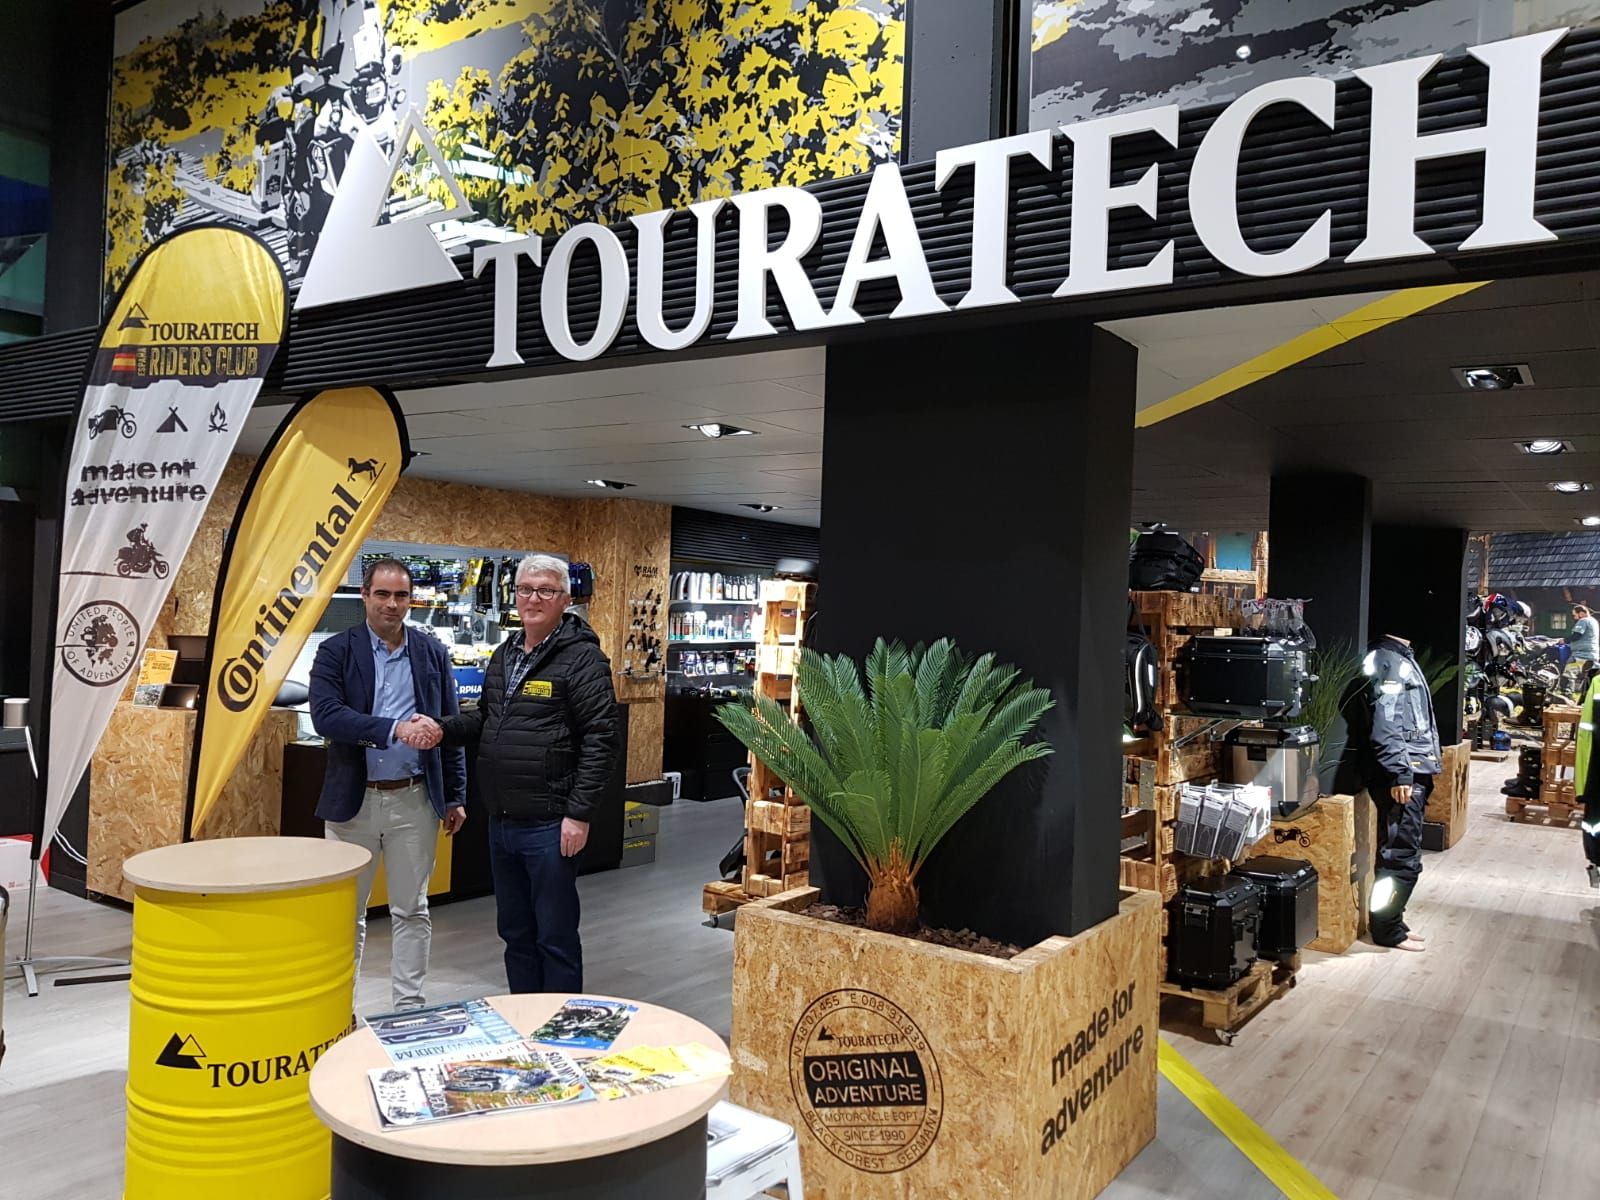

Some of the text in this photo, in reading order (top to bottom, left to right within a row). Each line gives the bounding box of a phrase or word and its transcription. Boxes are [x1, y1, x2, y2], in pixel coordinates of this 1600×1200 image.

[473, 27, 1569, 368] TOURATECH
[148, 322, 260, 341] TOURATECH
[149, 346, 259, 376] RIDERS CLUB
[80, 459, 197, 482] made for
[71, 484, 207, 506] adventure
[217, 482, 362, 712] Continental
[68, 606, 135, 638] UNITED PEOPLE
[66, 650, 133, 680] OF ADVENTURE
[836, 1033, 900, 1049] TOURATECH
[1051, 979, 1136, 1087] made for
[808, 1056, 919, 1082] ORIGINAL
[814, 1083, 923, 1104] ADVENTURE
[1041, 1024, 1144, 1156] adventure
[824, 1111, 890, 1122] MOTORCYCLE
[805, 1107, 939, 1169] BLACKFOREST GERMANY
[843, 1129, 906, 1141] SINCE 1990
